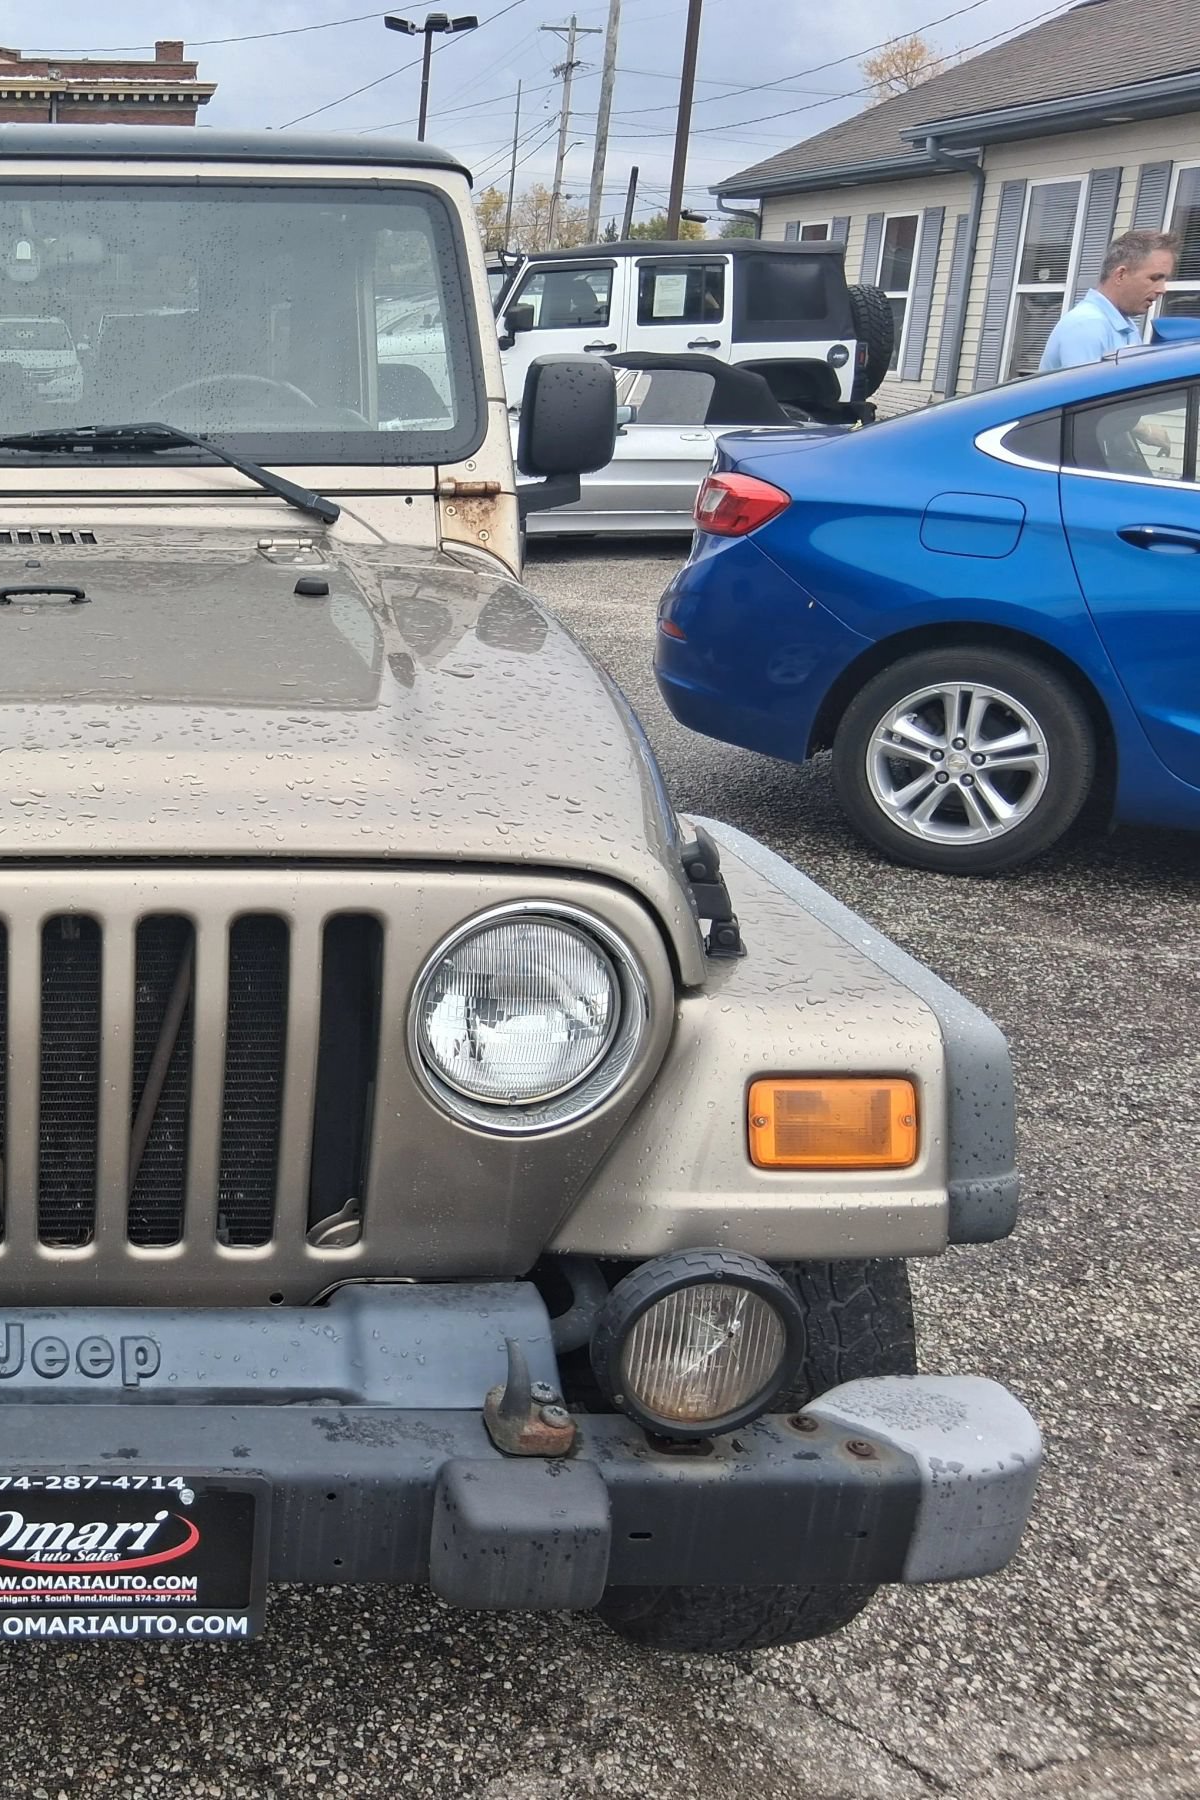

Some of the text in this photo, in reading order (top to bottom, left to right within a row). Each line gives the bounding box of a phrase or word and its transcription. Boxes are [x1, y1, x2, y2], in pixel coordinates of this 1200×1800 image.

[25, 1549, 122, 1563] Auto Sales
[30, 1594, 43, 1603] St.
[45, 1594, 71, 1603] South
[134, 1593, 198, 1603] 574-287-4714
